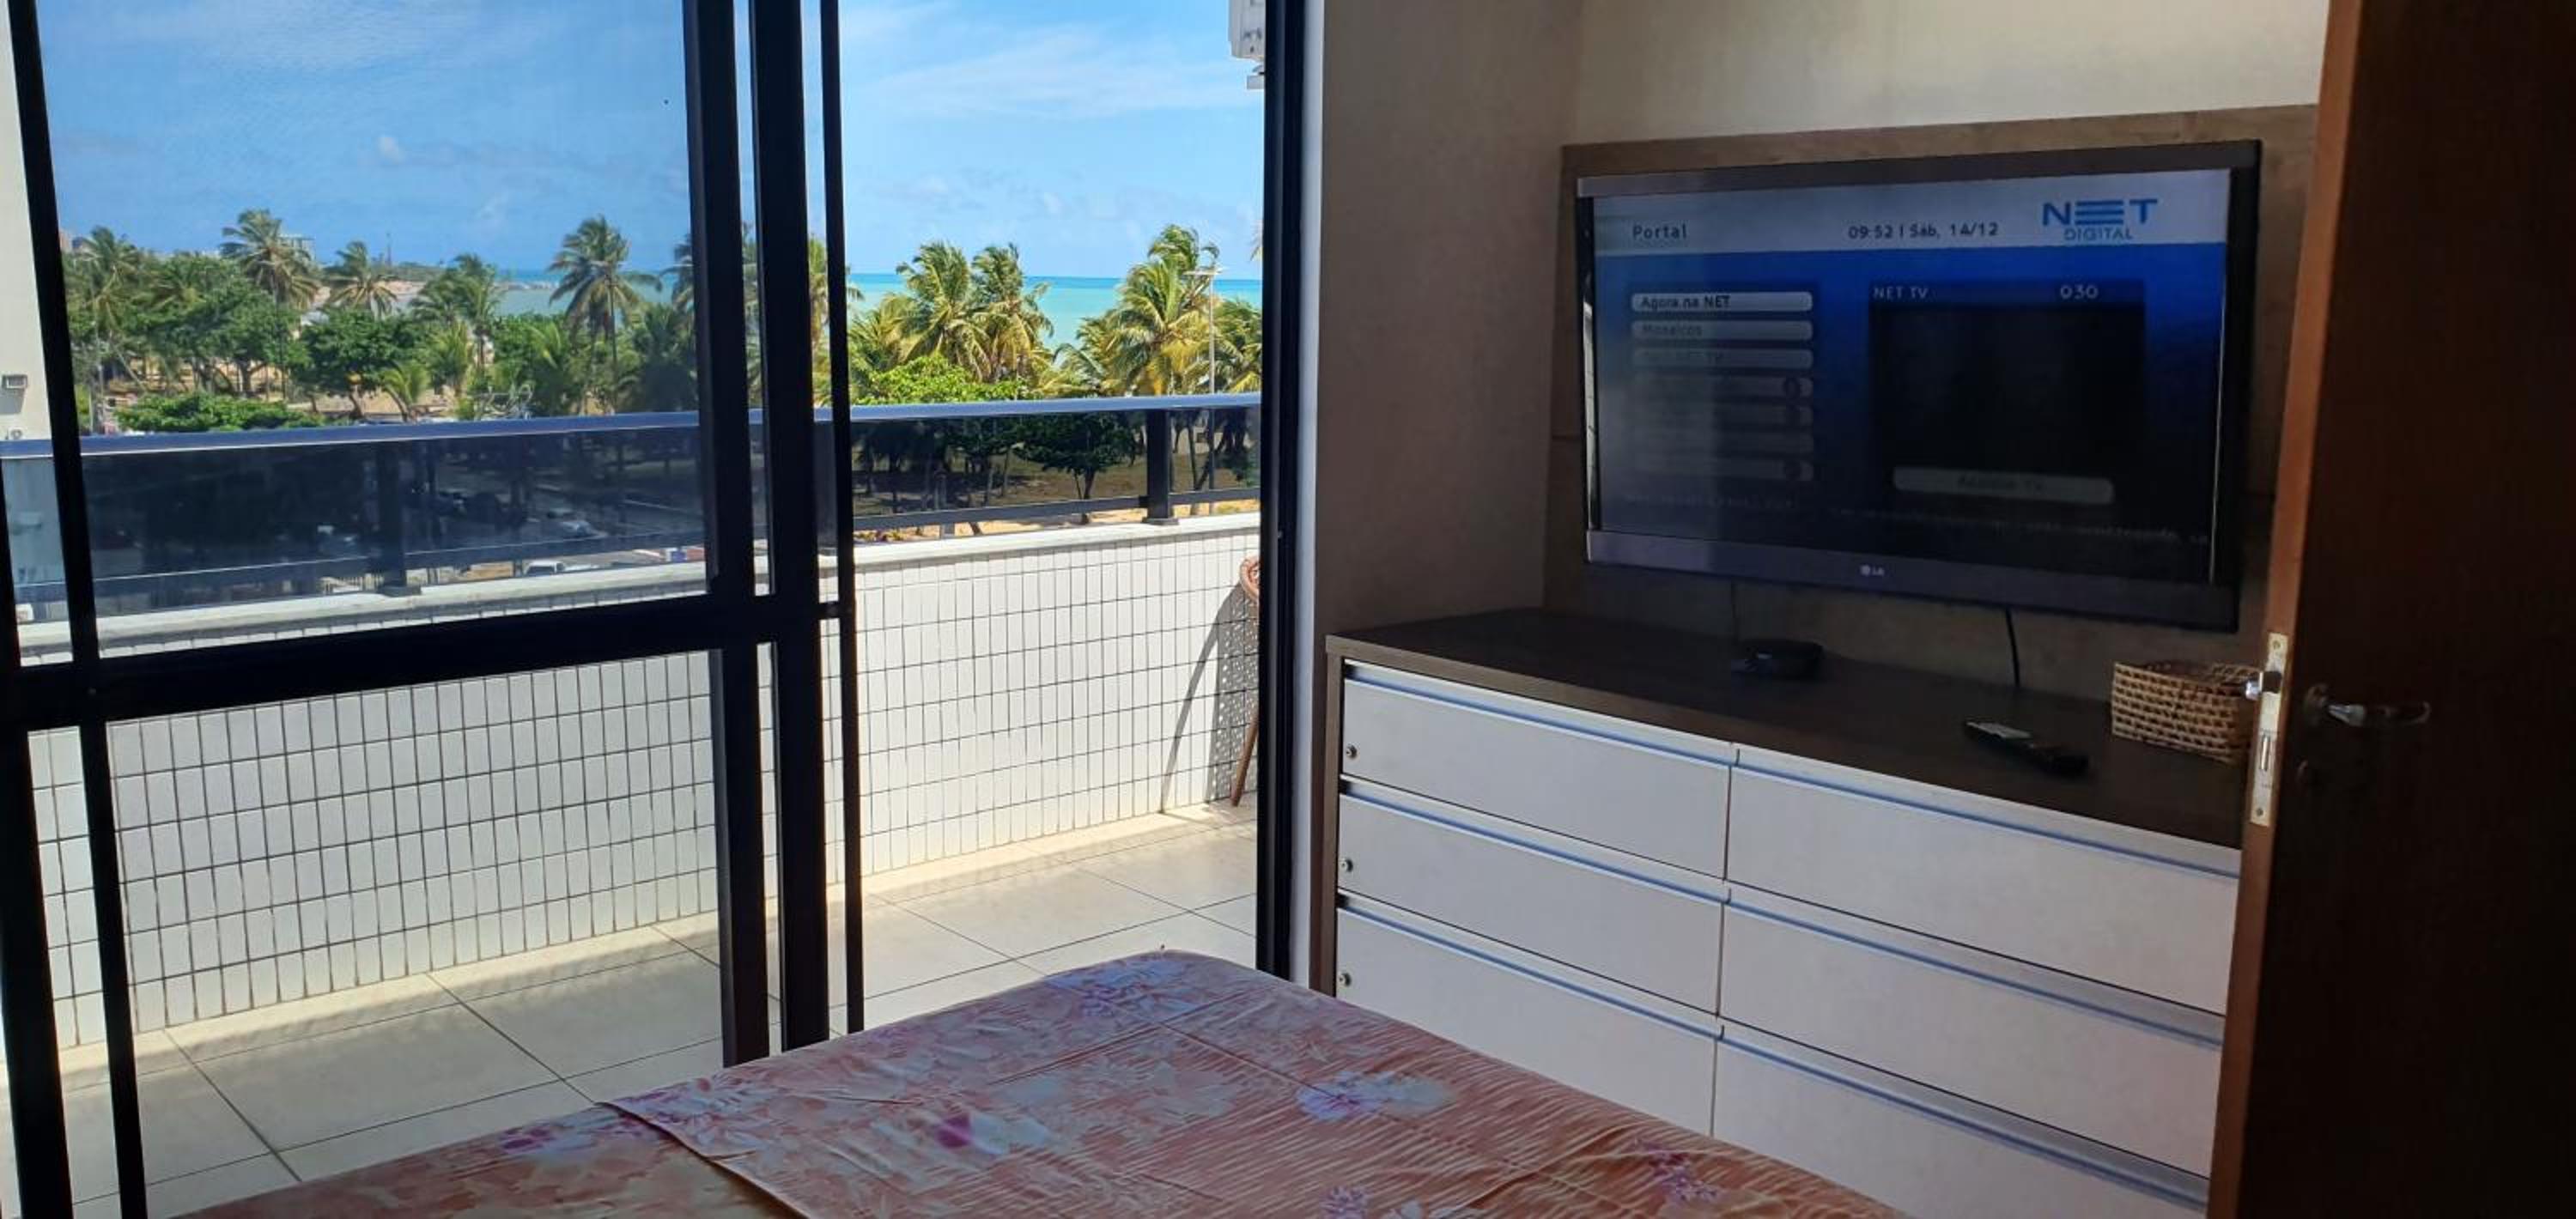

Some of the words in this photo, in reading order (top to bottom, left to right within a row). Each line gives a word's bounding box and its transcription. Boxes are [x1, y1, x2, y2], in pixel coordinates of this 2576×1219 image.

[2042, 198, 2159, 227] NET
[1631, 224, 1688, 240] Portal
[1848, 225, 1893, 240] 09:52
[1950, 221, 2000, 237] 14/12
[2063, 227, 2134, 241] DIGITAL
[1873, 286, 1904, 300] NET
[1910, 286, 1930, 300] TV
[2060, 284, 2099, 300] 030
[1641, 297, 1679, 311] Agora
[1682, 297, 1700, 308] na
[1704, 295, 1732, 308] NET
